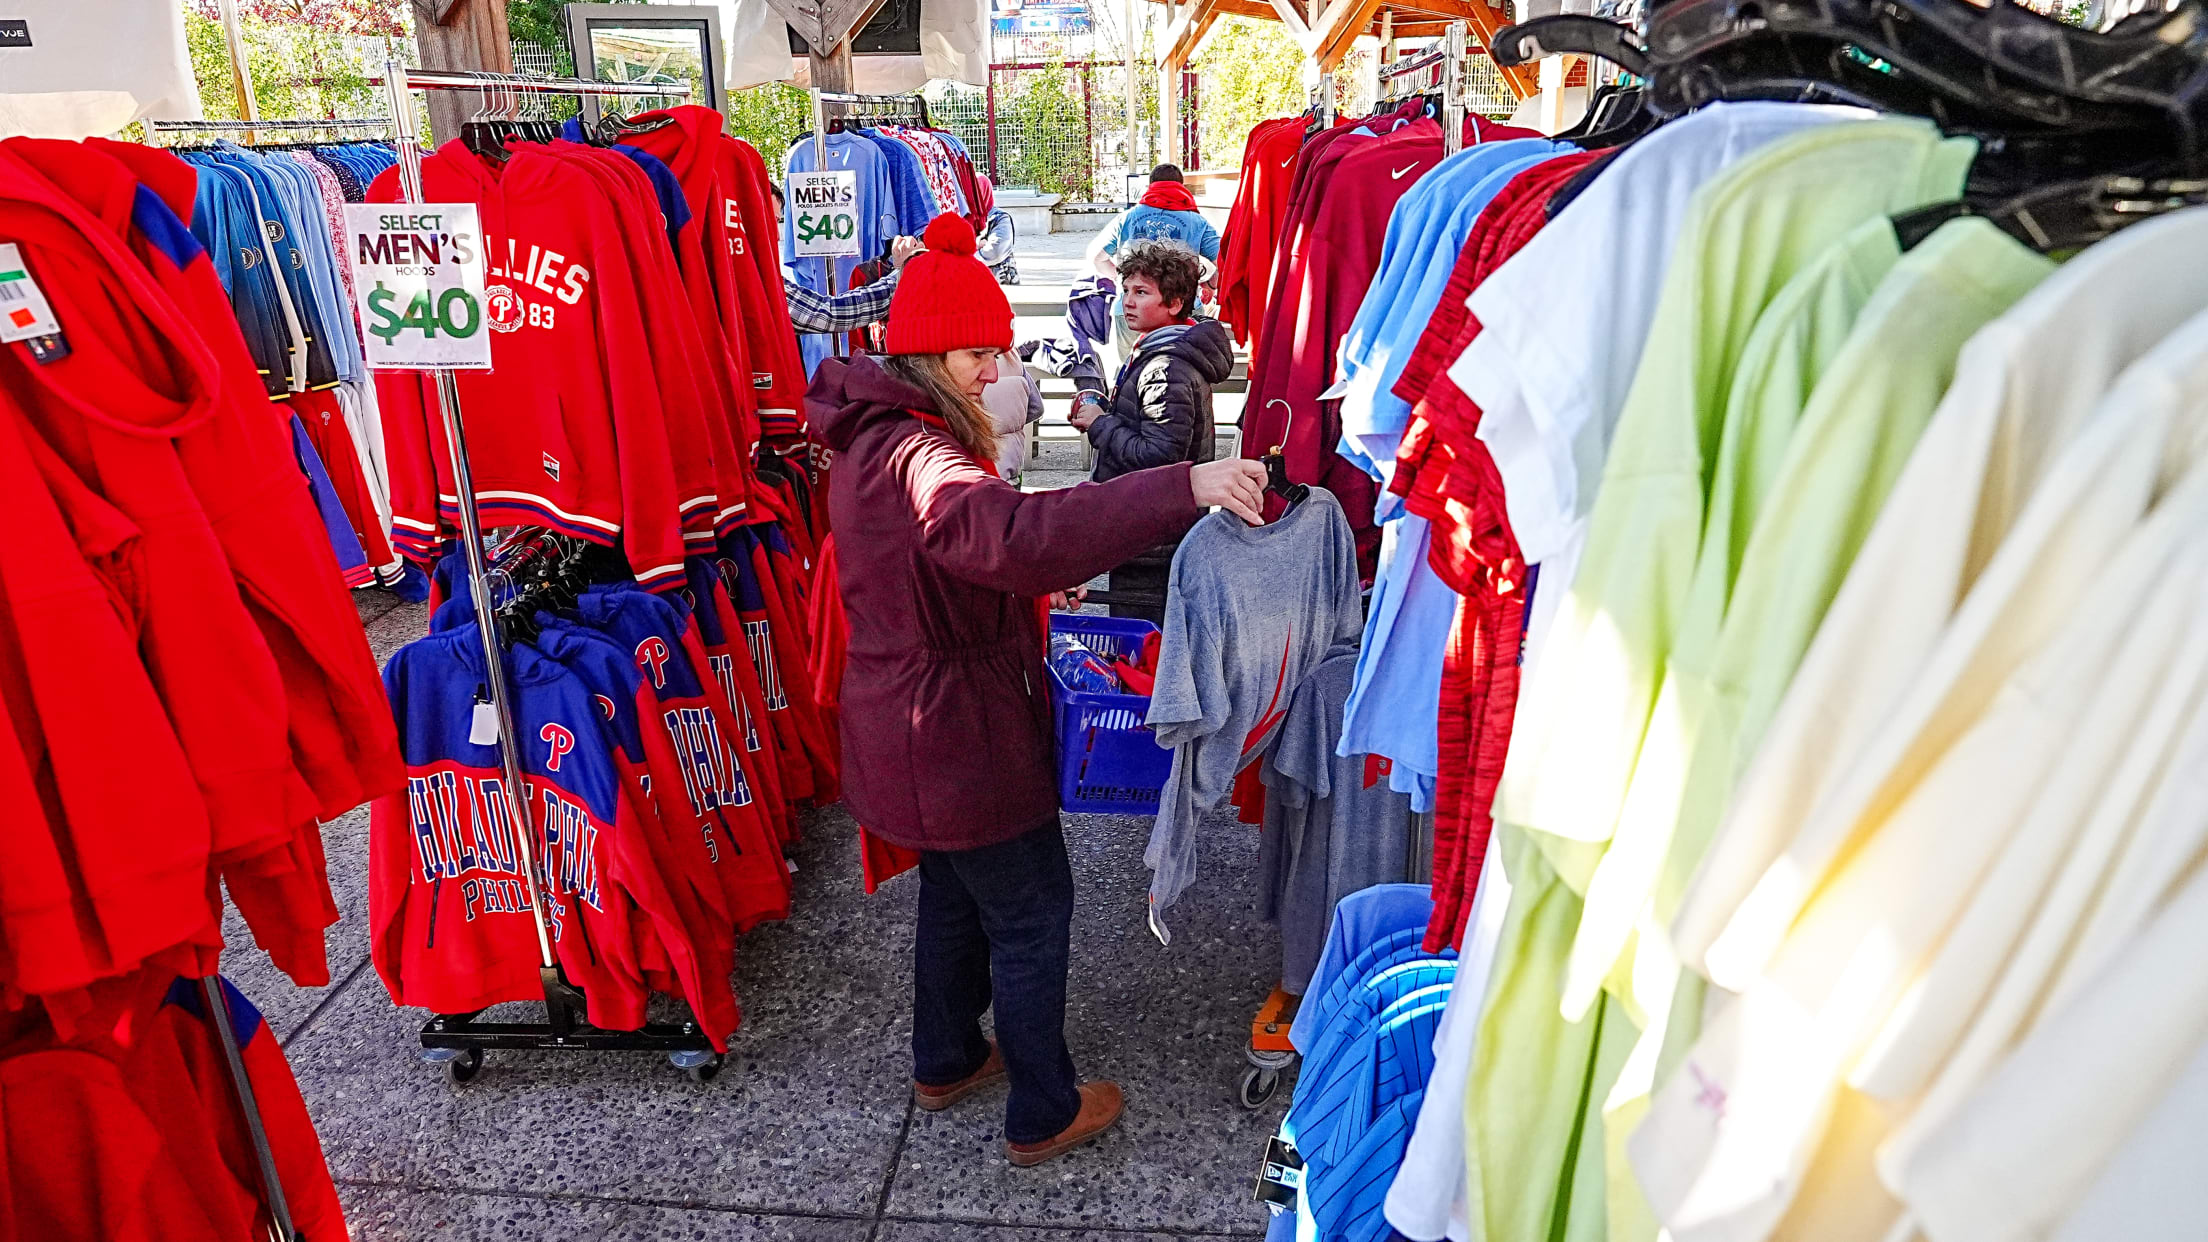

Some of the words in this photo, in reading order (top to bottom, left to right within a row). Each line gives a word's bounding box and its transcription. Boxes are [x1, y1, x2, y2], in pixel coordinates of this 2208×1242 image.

[795, 186, 852, 204] MEN'S
[806, 177, 837, 187] SELECT
[380, 215, 442, 231] SELECT
[797, 211, 854, 245] $40
[358, 233, 474, 265] MEN'S
[396, 266, 436, 276] HOODS
[368, 280, 480, 346] $40
[529, 302, 555, 330] 83
[540, 722, 575, 772] P
